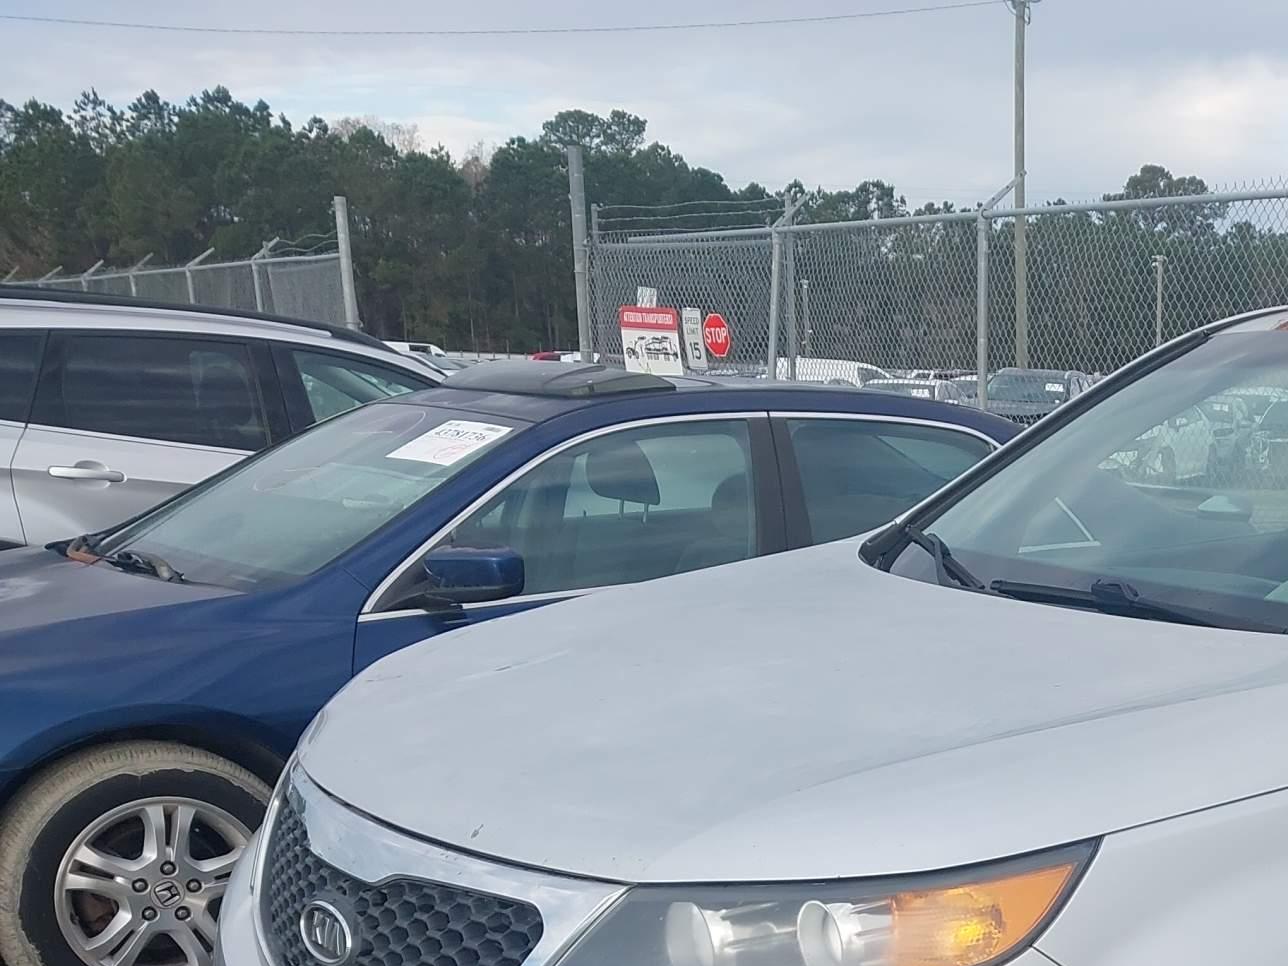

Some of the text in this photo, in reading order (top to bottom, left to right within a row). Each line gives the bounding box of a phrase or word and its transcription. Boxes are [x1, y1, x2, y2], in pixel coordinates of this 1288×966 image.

[684, 316, 700, 325] SPEED
[705, 327, 727, 344] STOP
[689, 341, 702, 360] 15
